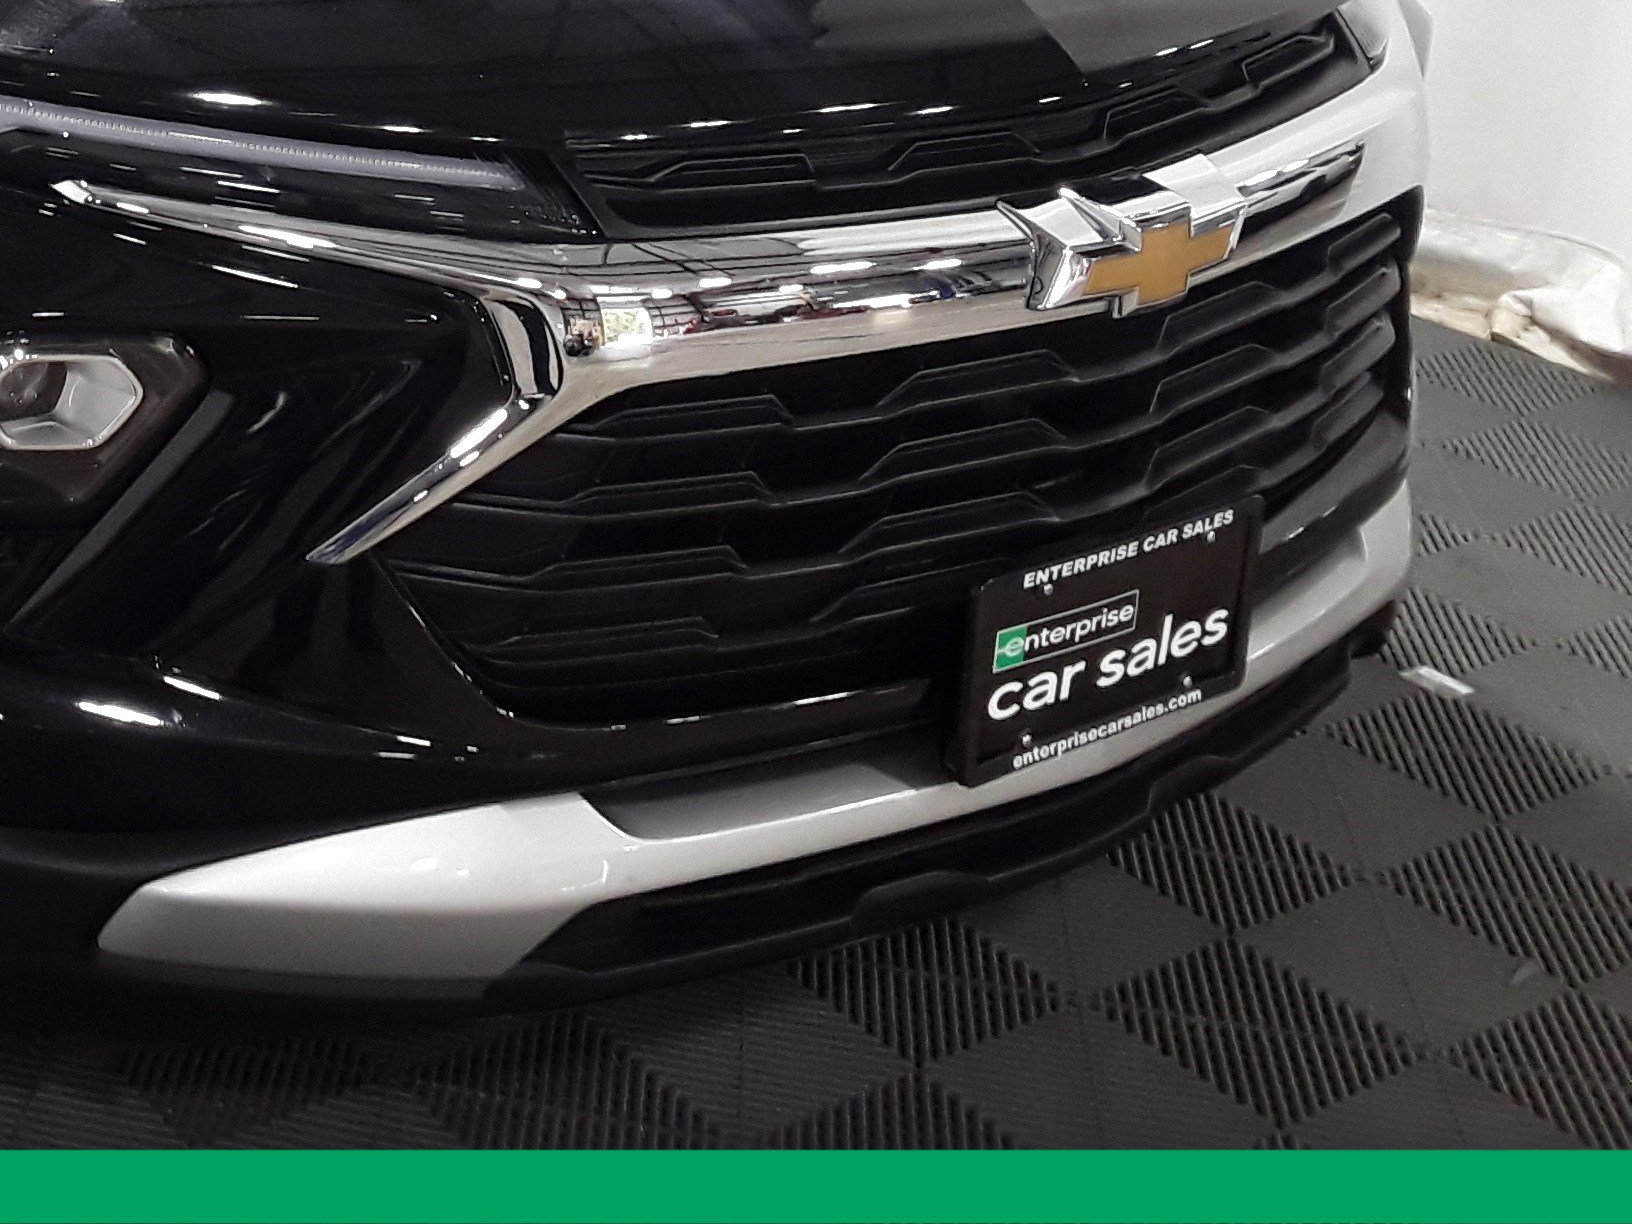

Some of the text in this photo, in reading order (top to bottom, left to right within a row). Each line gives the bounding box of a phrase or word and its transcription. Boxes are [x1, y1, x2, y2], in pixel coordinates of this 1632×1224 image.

[1022, 508, 1234, 590] ENTERPRISE CAR SALES
[987, 608, 1229, 721] car sales
[1002, 602, 1135, 657] enterprise
[1012, 687, 1202, 769] enterprisecarsales.com
